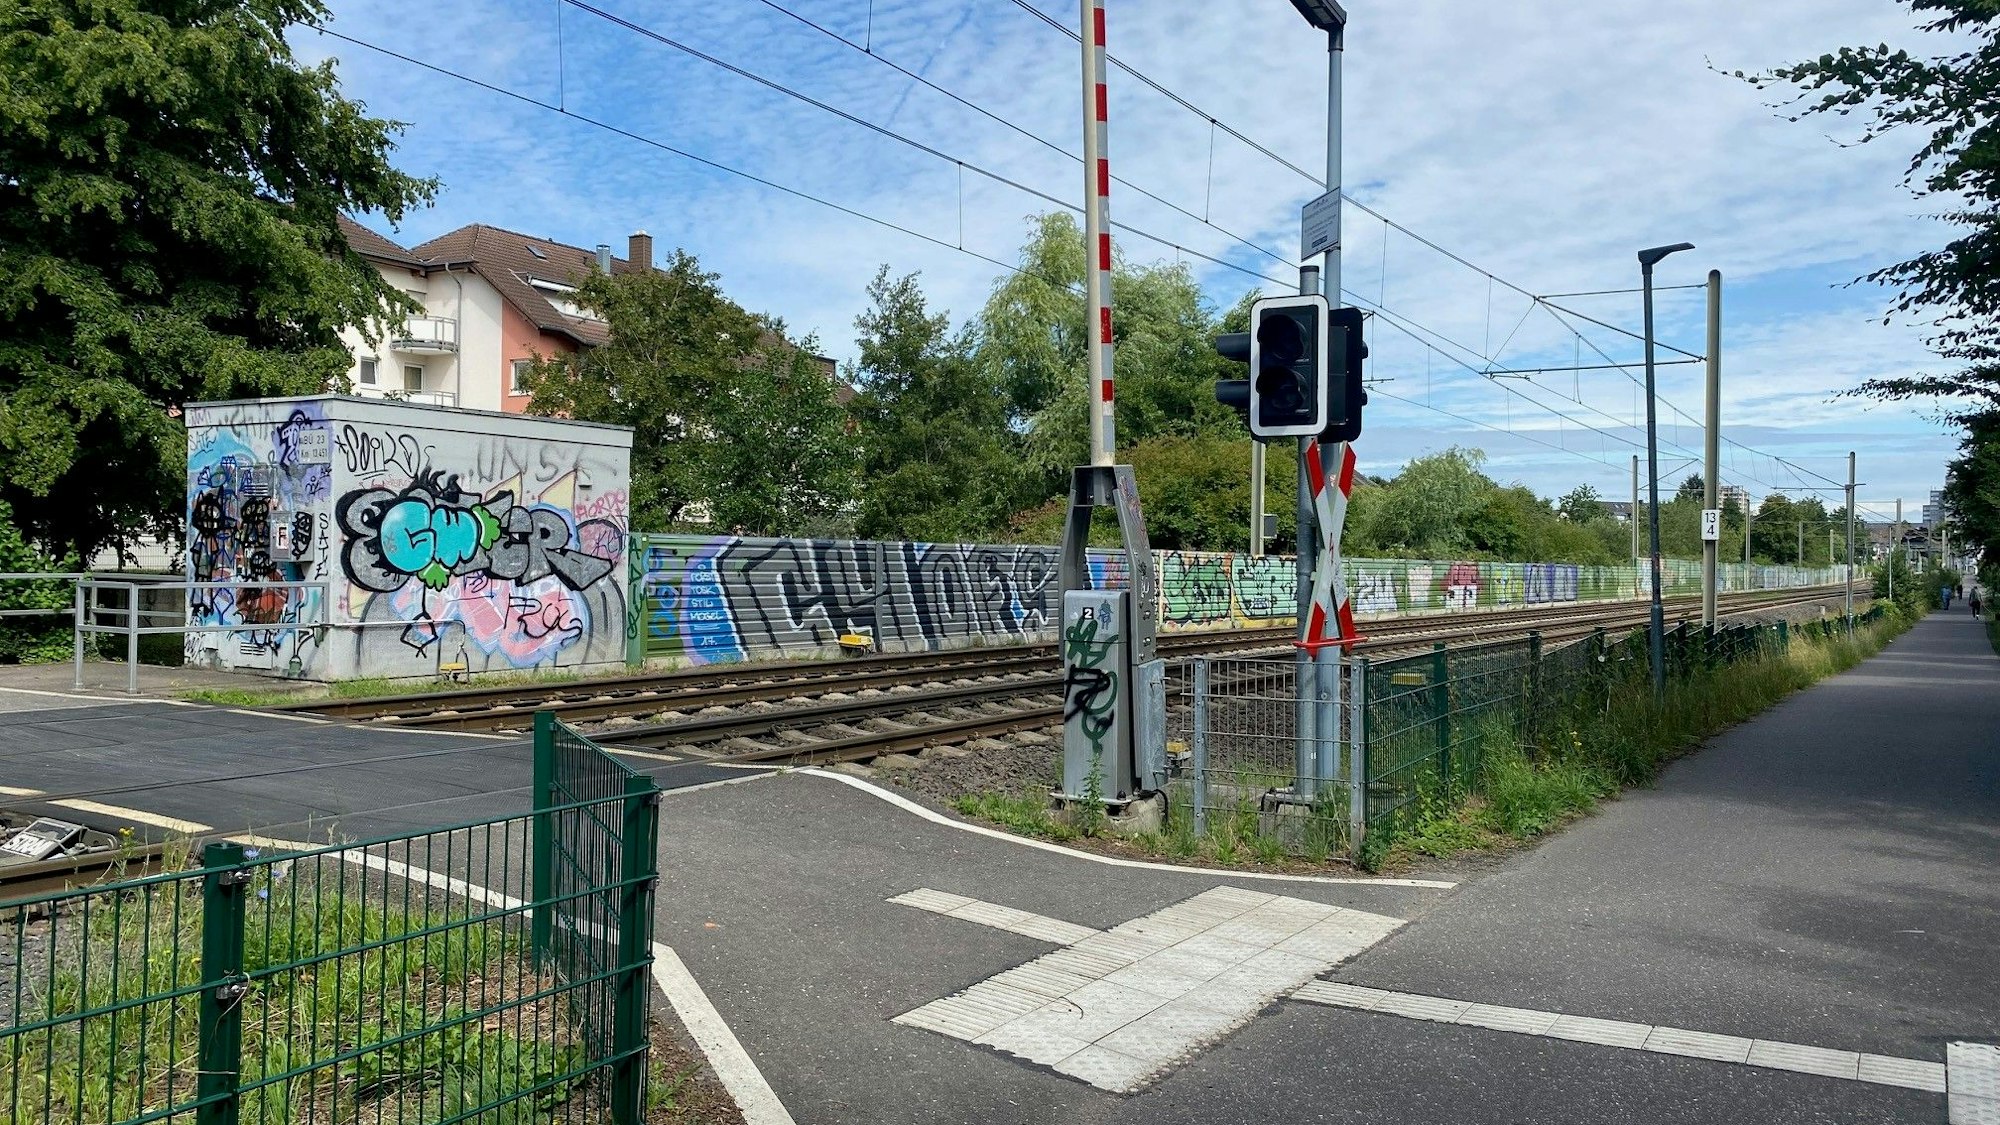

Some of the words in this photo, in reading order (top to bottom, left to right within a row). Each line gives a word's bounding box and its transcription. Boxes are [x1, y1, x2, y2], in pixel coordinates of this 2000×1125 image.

[1705, 512, 1716, 523] 13
[1707, 525, 1714, 535] 4
[1084, 608, 1093, 619] 2
